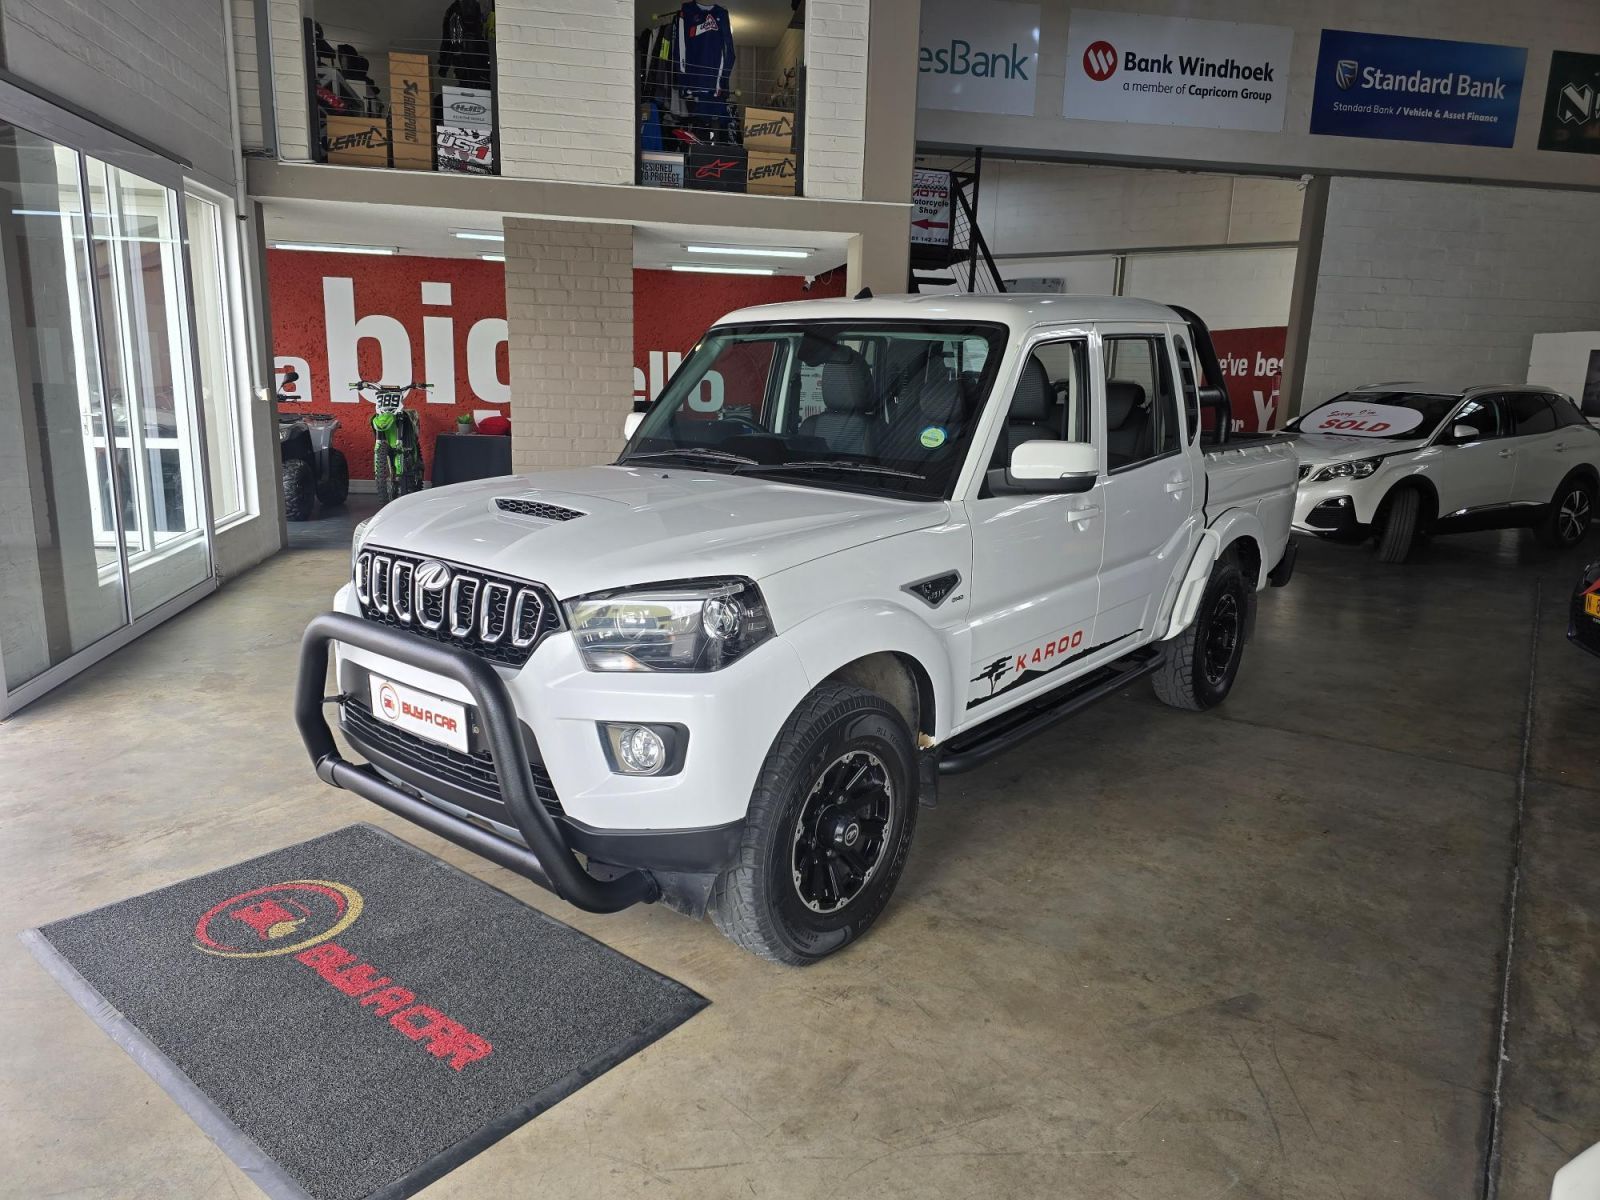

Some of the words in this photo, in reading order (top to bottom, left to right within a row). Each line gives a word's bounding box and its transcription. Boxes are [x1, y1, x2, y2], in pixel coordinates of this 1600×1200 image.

[1124, 52, 1172, 75] Bank
[1179, 55, 1274, 82] Windhoek
[1131, 82, 1173, 94] member
[1175, 83, 1187, 94] of
[1188, 85, 1238, 100] Capricorn
[1241, 88, 1272, 103] Group
[1361, 66, 1452, 95] Standard
[1457, 74, 1506, 100] Bank
[1333, 101, 1372, 114] Standard
[1373, 105, 1394, 115] Bank
[1403, 107, 1433, 118] Vehicle
[1434, 109, 1441, 118] &
[1443, 110, 1465, 120] Asset
[1466, 112, 1499, 123] Finance
[650, 172, 680, 183] PROTECT
[912, 198, 949, 208] otorcycle
[919, 206, 938, 216] Shop
[1218, 352, 1249, 377] e've
[376, 394, 401, 409] 389
[1327, 409, 1354, 418] Sorry
[1319, 418, 1391, 432] SOLD
[1014, 630, 1084, 673] KAROO
[402, 702, 423, 720] BUY
[425, 710, 432, 724] A
[435, 714, 457, 733] CAR
[296, 942, 392, 998] BUY
[360, 986, 416, 1017] A
[390, 1004, 493, 1072] CAR
